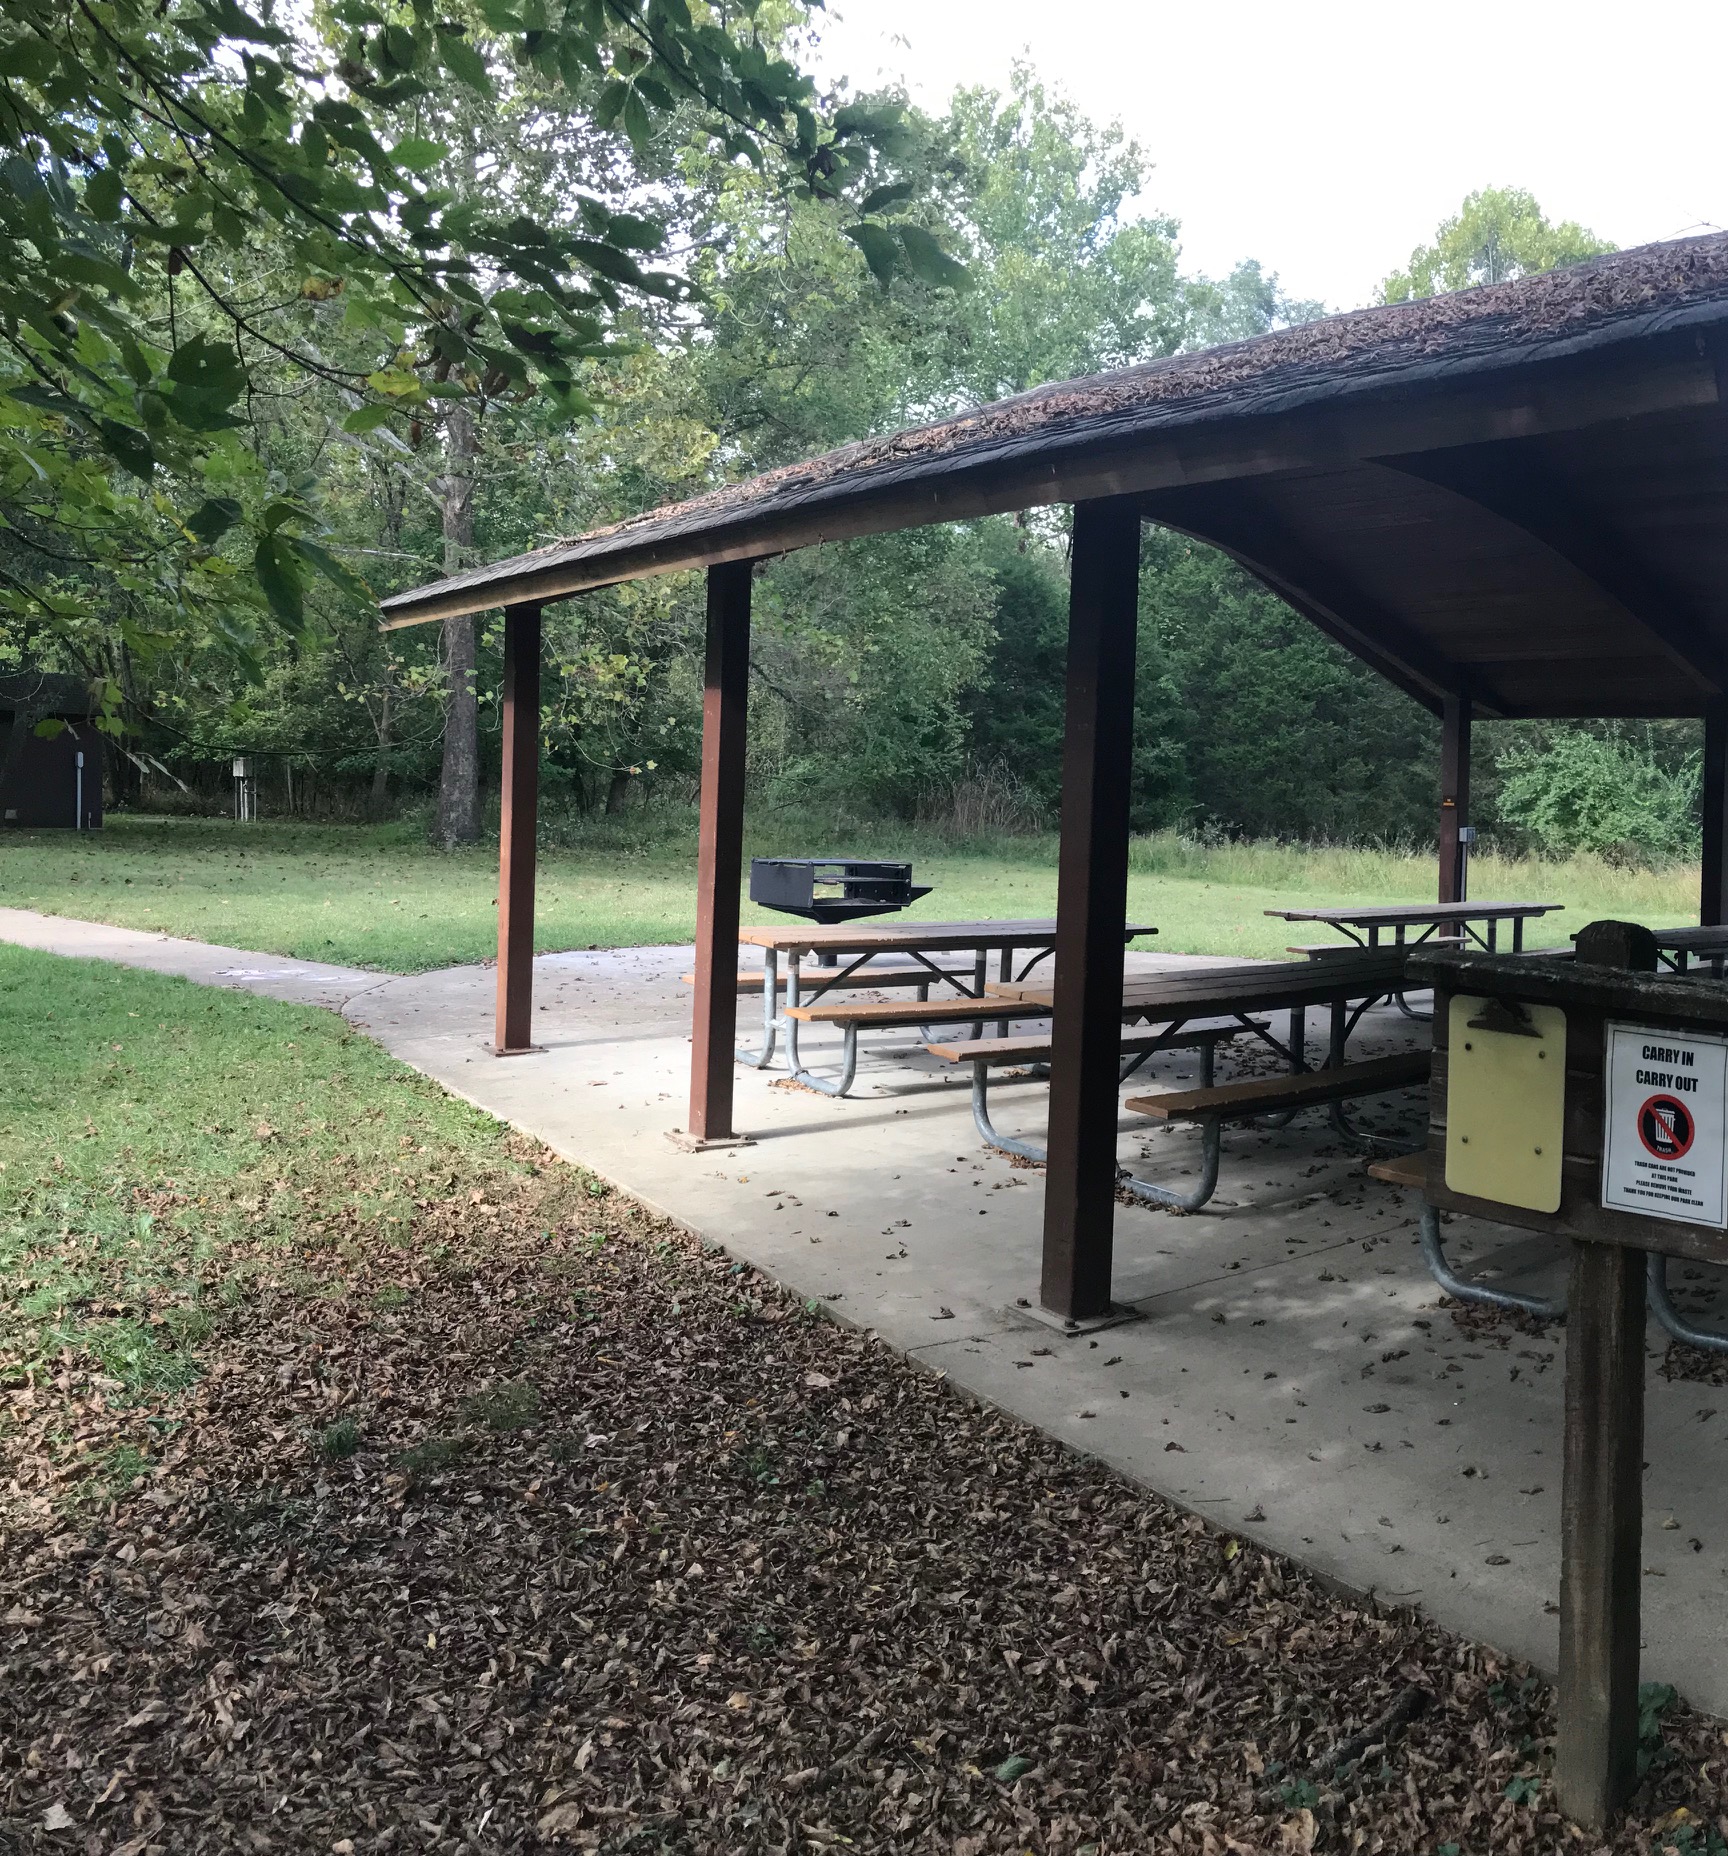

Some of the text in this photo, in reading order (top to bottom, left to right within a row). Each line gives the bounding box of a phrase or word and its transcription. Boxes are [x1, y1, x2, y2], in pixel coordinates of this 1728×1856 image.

[1642, 1046, 1694, 1066] CARRY IN
[1636, 1070, 1698, 1092] CARRY OUT
[1676, 1168, 1696, 1177] PROVIDED
[1654, 1192, 1670, 1200] KEEPING
[1678, 1187, 1692, 1196] WASTE
